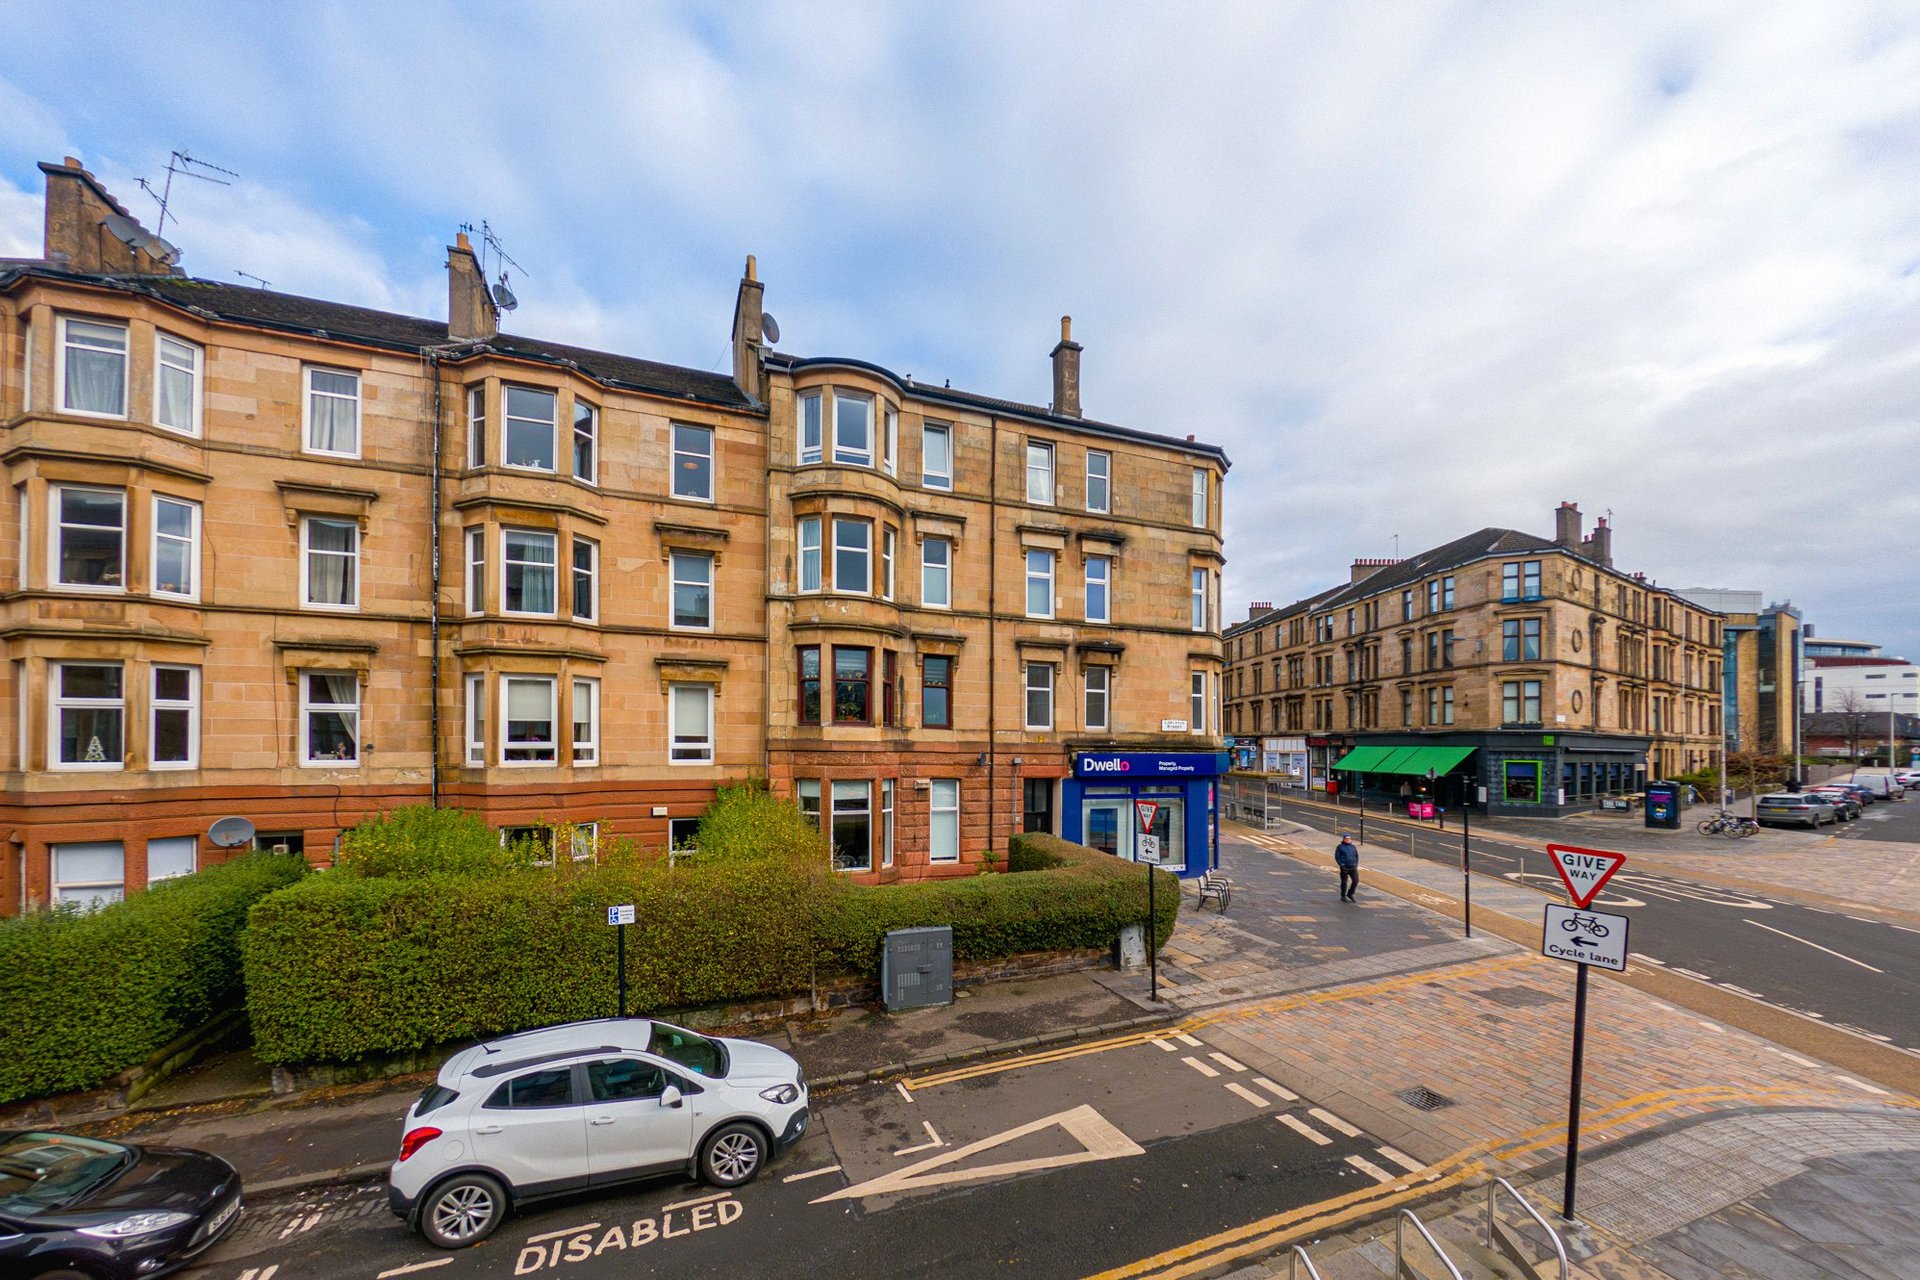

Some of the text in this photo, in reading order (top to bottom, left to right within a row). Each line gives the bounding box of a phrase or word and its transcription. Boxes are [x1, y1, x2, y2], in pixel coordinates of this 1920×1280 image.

[1084, 758, 1130, 771] Dwello
[1562, 853, 1606, 871] GIVE
[1569, 869, 1597, 880] WAY
[1549, 944, 1618, 965] Cycle lane
[514, 1199, 744, 1275] DISABLED
